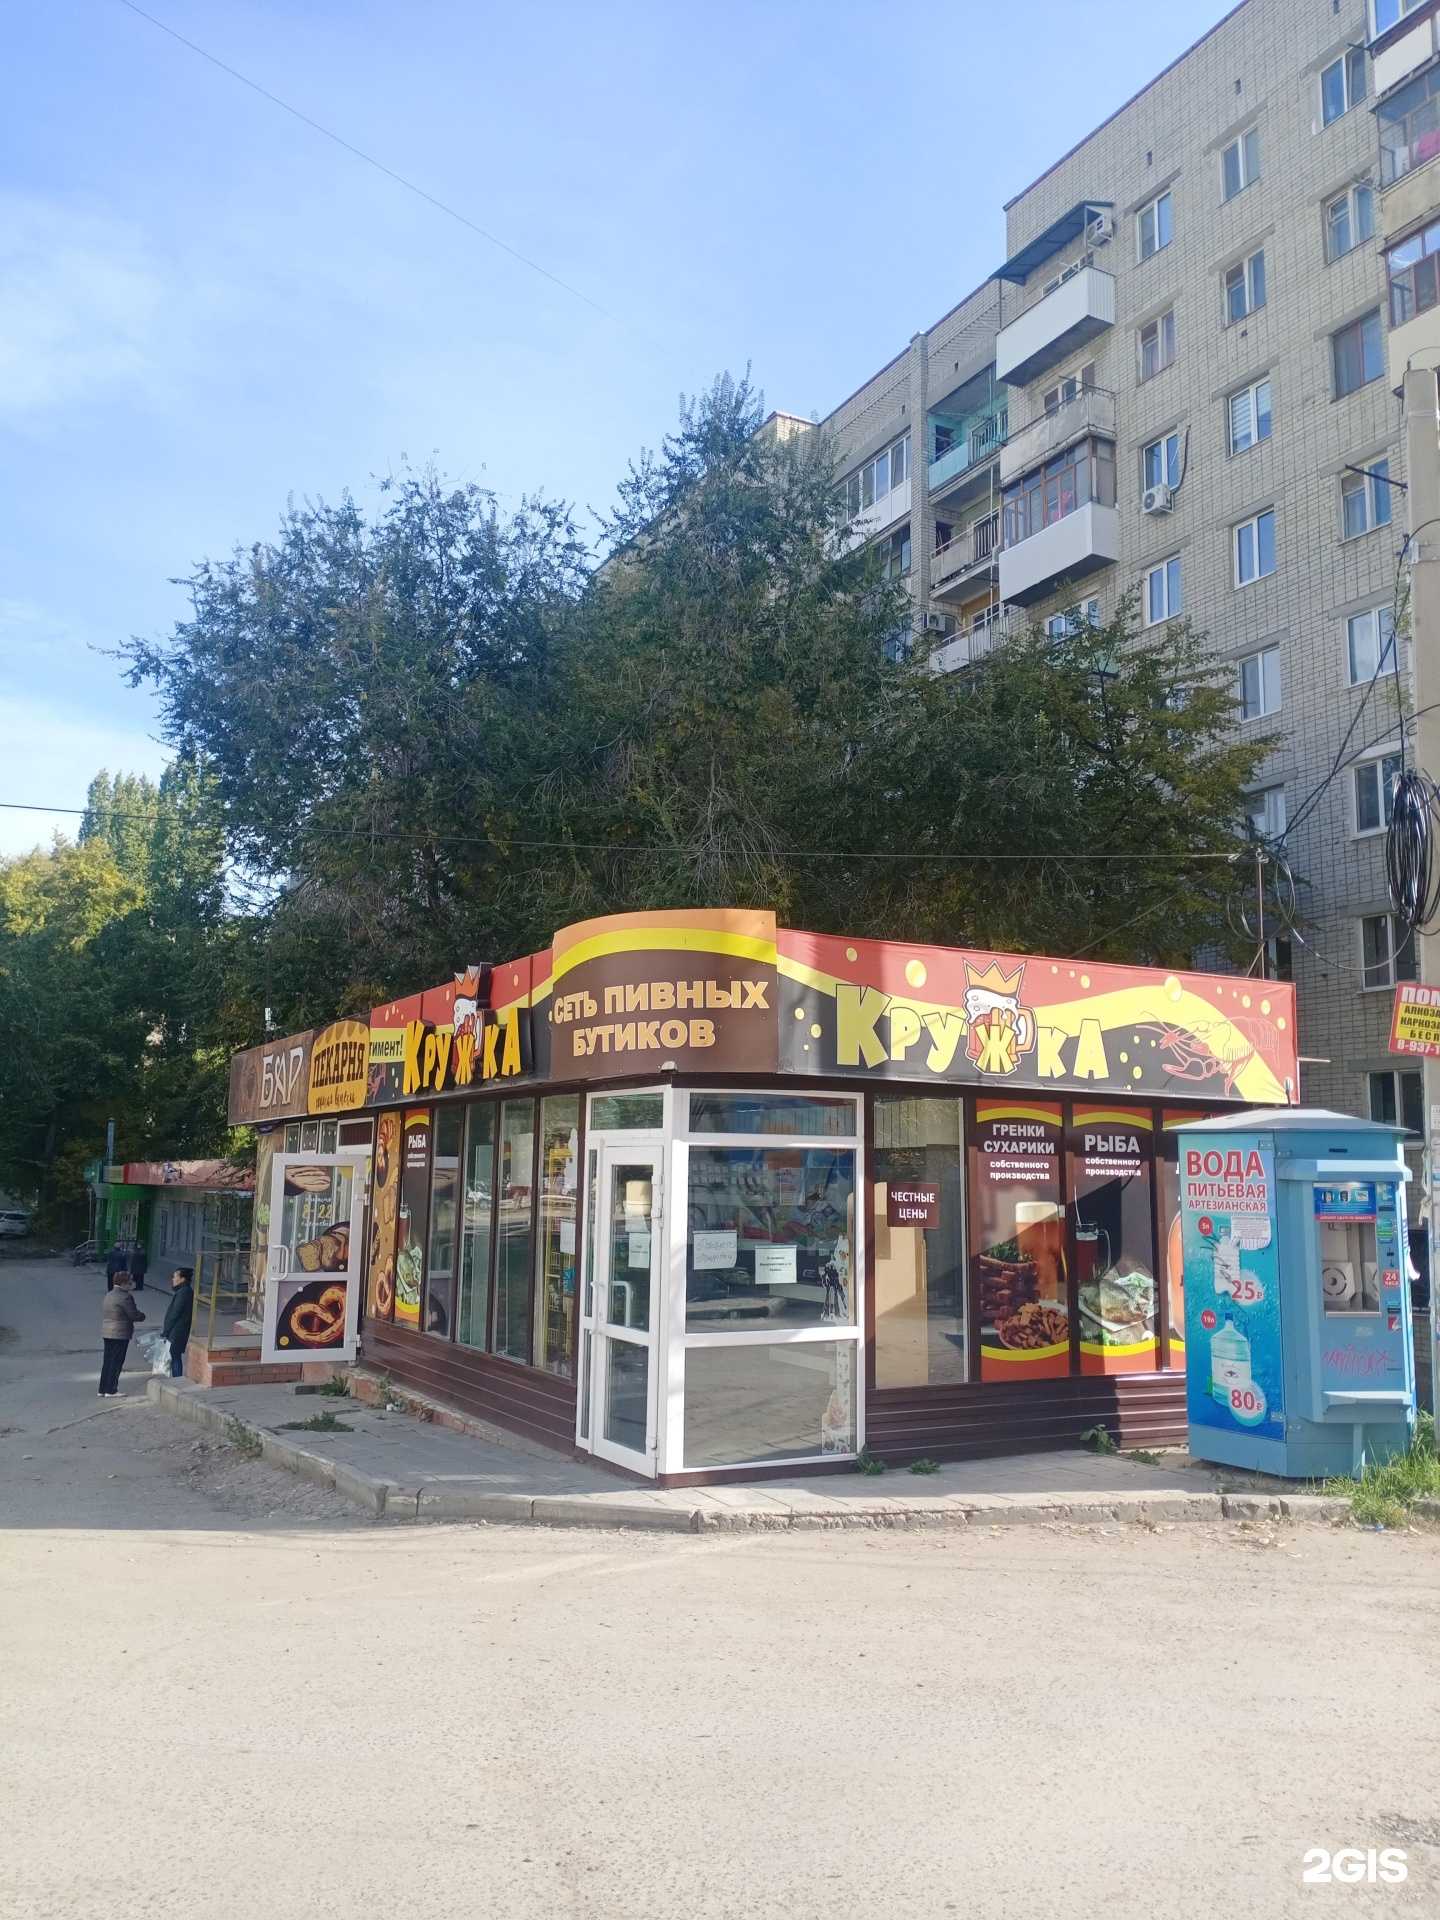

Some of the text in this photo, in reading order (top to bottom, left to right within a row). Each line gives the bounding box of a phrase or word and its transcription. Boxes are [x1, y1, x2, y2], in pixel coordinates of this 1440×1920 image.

[554, 980, 770, 1024] СЕТЬ ПИВНЫХ
[573, 1019, 716, 1057] БУТИКОВ
[312, 1042, 366, 1089] ПЕКАРНЯ
[992, 1124, 1045, 1138] ГРЕНКИ
[408, 1134, 427, 1149] РЫБА
[983, 1140, 1055, 1154] СУХАРИКИ
[1084, 1134, 1140, 1153] РЫБА
[990, 1160, 1050, 1169] собственного
[1085, 1157, 1141, 1167] собственного
[1186, 1150, 1265, 1184] ВОДА
[990, 1172, 1050, 1181] производства
[891, 1191, 936, 1204] ЧЕСТНЫЕ
[1187, 1183, 1266, 1200] ПИТЬЕВАЯ
[1188, 1199, 1267, 1212] АРТЕЗИАНСКАЯ
[899, 1208, 928, 1221] ЦЕНЫ
[1385, 1272, 1397, 1281] 24
